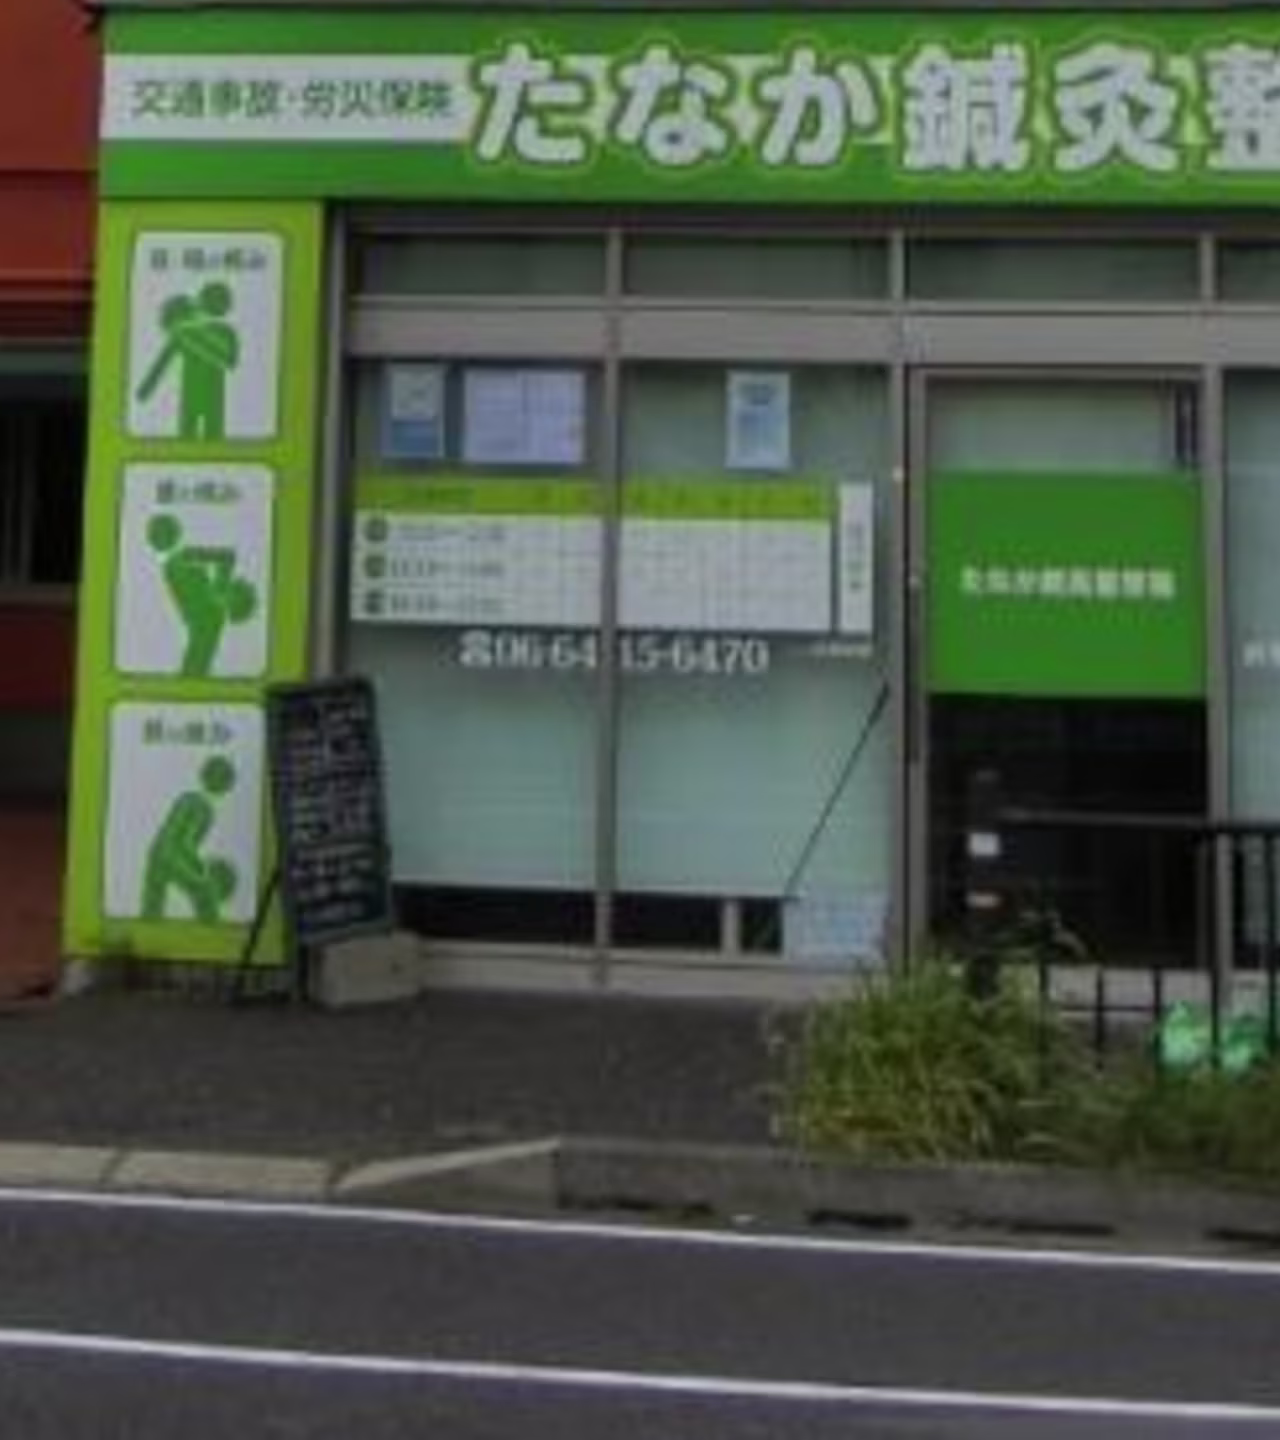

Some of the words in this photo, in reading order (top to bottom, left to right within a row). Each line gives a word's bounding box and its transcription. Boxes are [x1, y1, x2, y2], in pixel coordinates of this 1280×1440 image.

[131, 77, 453, 117] 交通事故・労災保険
